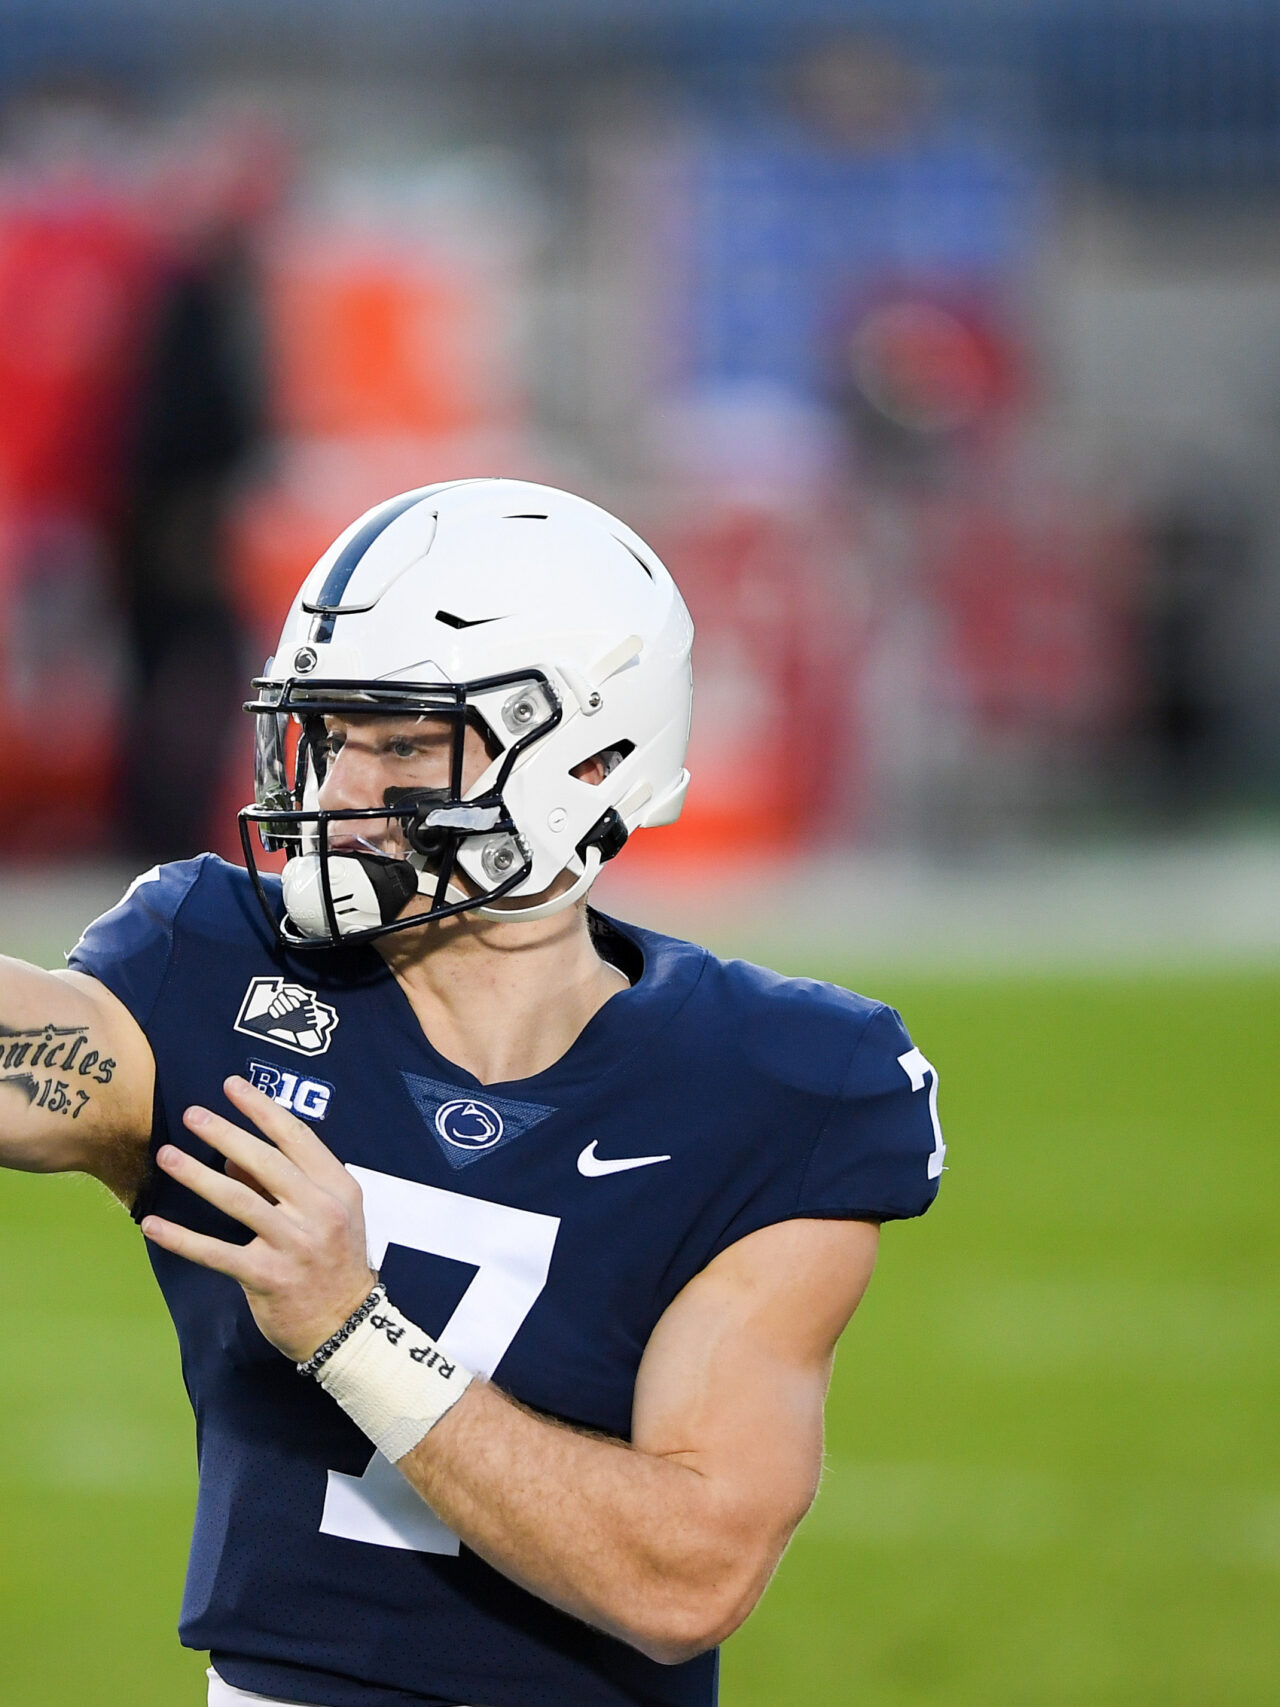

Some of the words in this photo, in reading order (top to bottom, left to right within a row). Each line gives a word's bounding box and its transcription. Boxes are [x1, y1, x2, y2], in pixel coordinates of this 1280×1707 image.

[36, 1078, 90, 1119] 15:7
[319, 1162, 561, 1557] 7
[409, 1346, 456, 1380] RIP
